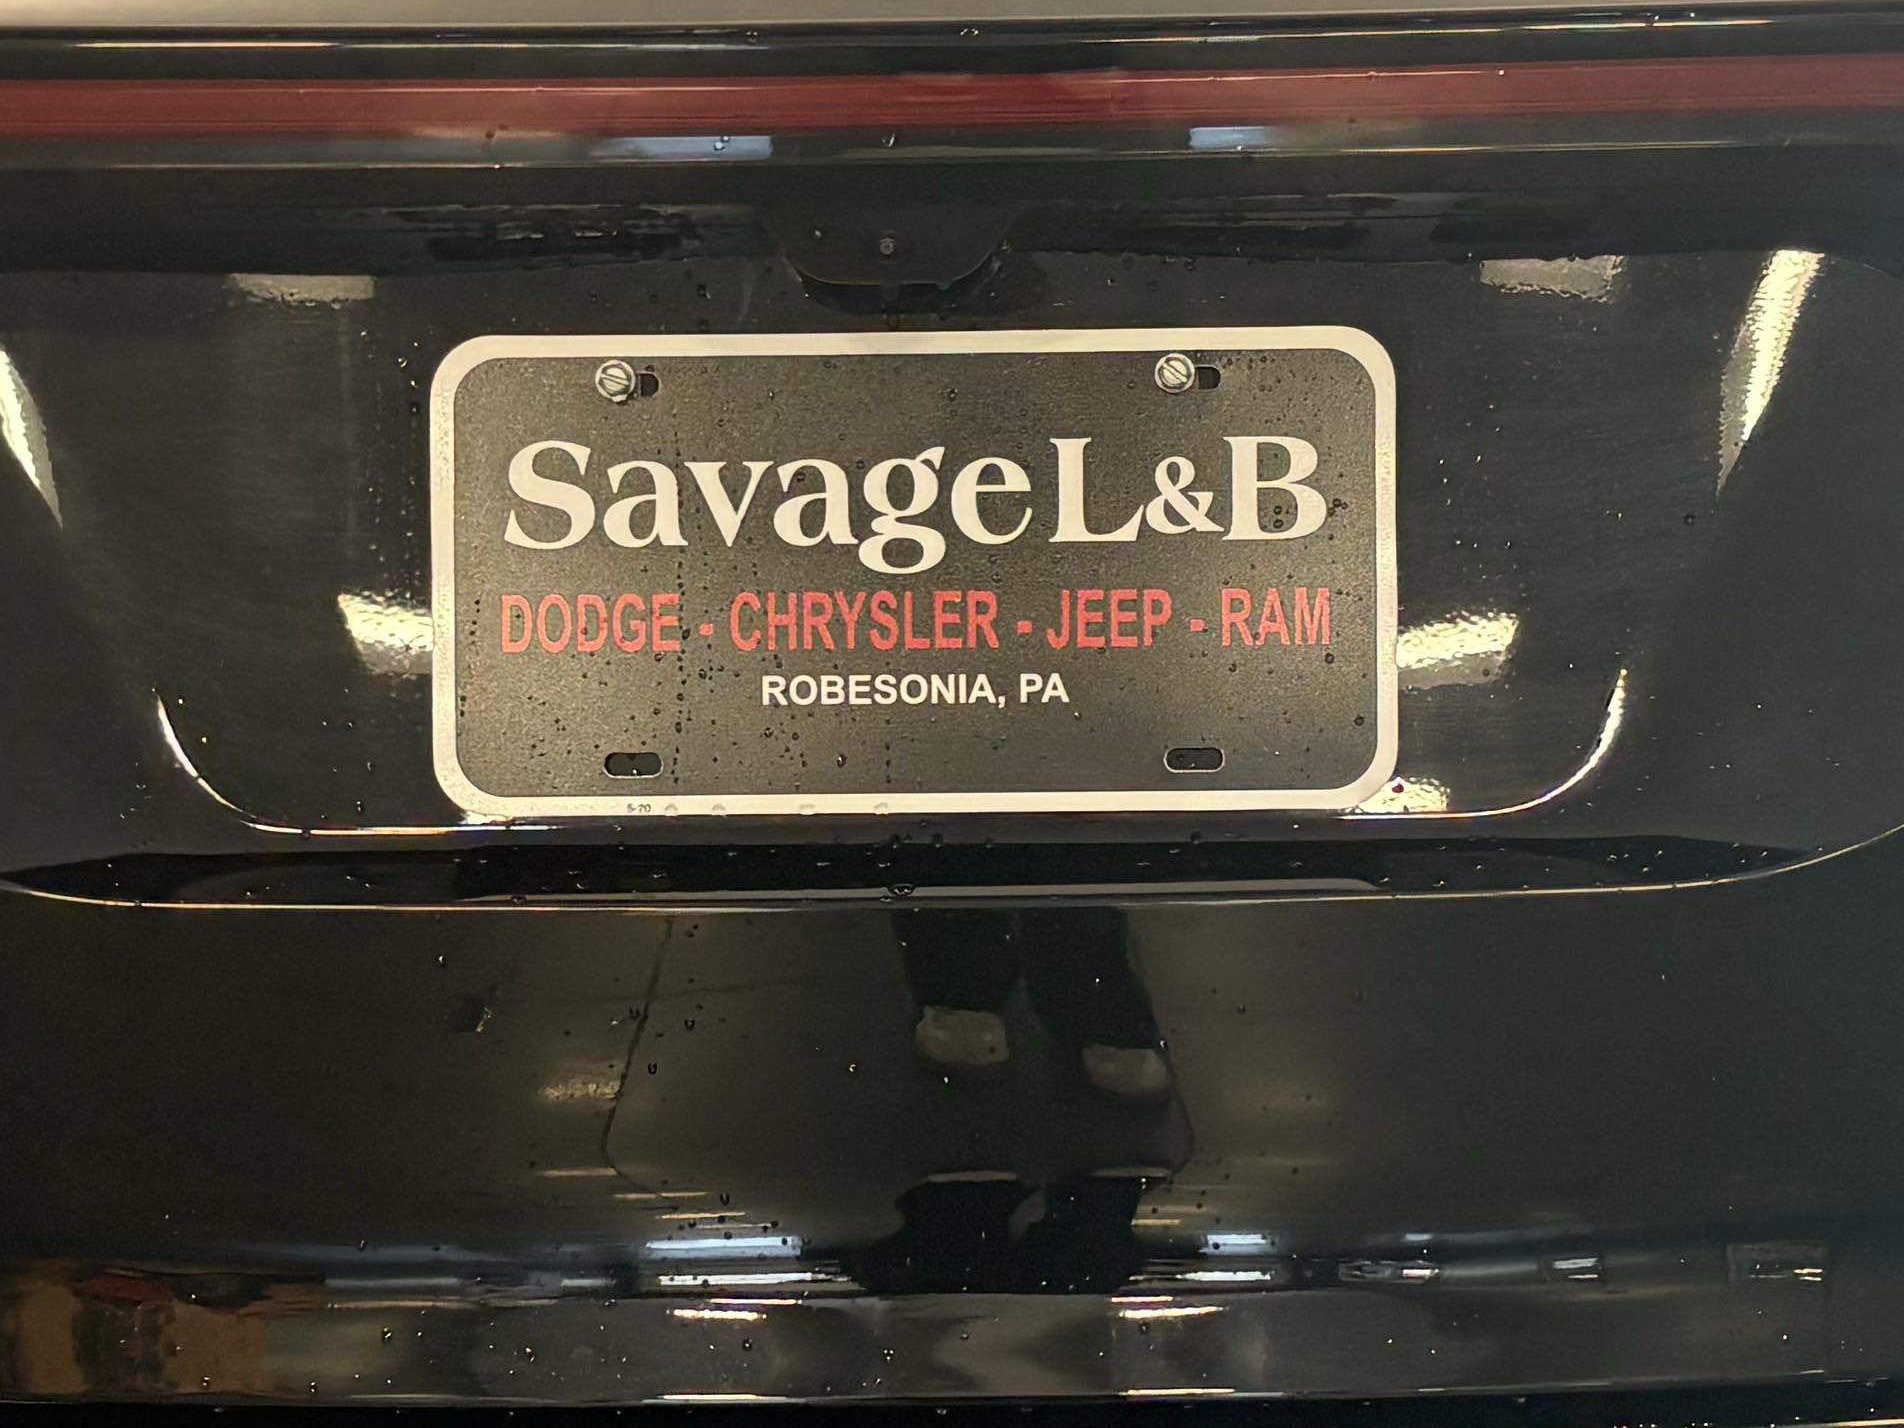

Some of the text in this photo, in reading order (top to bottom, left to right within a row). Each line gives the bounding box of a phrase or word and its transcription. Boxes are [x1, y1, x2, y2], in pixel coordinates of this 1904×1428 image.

[498, 591, 682, 655] DODGE
[728, 588, 1001, 653] CHRYSLER
[1044, 587, 1174, 650] JEEP
[1218, 587, 1333, 648] RAM
[761, 672, 1070, 709] ROBESONIA, PA
